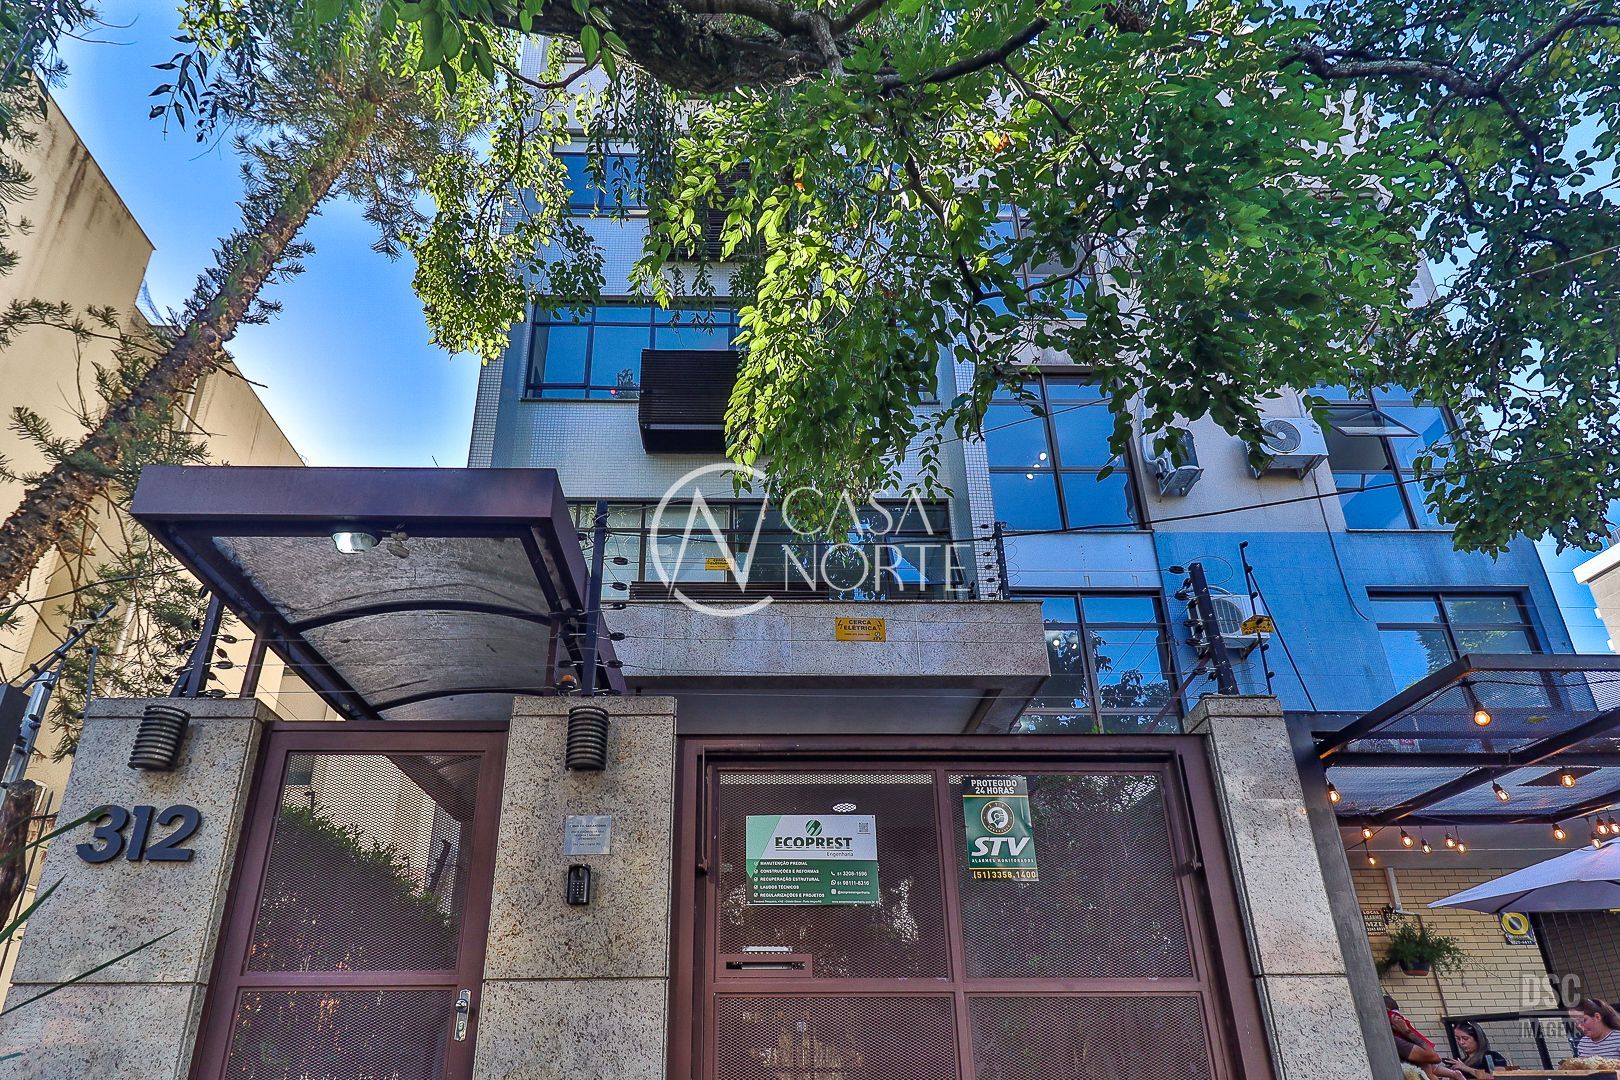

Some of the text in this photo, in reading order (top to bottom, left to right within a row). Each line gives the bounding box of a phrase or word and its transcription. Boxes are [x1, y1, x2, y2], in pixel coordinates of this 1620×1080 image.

[970, 779, 1017, 787] PROTEGIDO
[974, 786, 1015, 795] 24 HORAS
[76, 804, 201, 864] 312
[775, 836, 853, 849] ECOPREST
[971, 836, 1031, 857] STV
